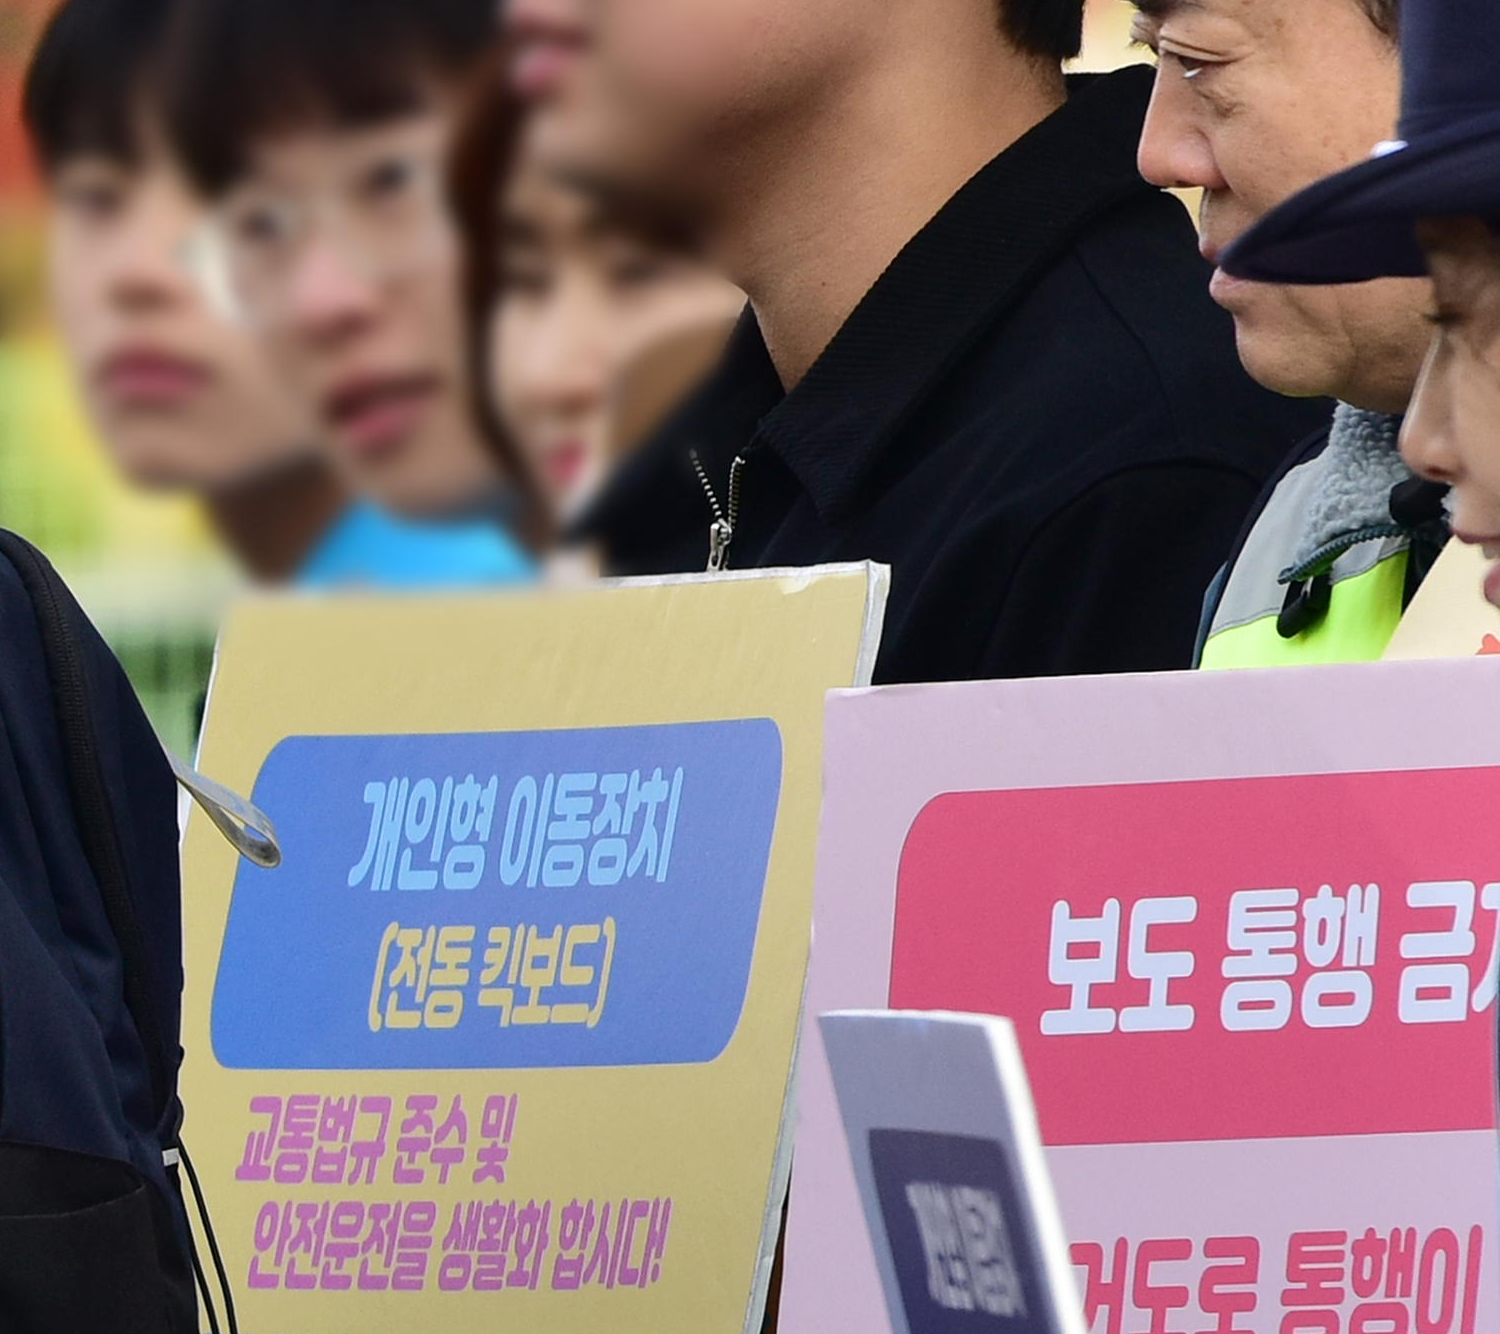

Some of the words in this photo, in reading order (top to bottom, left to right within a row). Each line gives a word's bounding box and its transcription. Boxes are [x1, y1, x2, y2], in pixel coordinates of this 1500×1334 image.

[348, 774, 498, 891] 개인형
[500, 767, 683, 888] 이동장치
[1040, 896, 1197, 1035] 보도
[1220, 882, 1380, 1031] 통행
[234, 1094, 392, 1186] 교통법규
[393, 1093, 467, 1185] 준수
[472, 1093, 518, 1184] 및
[247, 1200, 437, 1292] 안전운전을
[438, 1198, 551, 1291] 생활화
[551, 1197, 672, 1291] 합시다!
